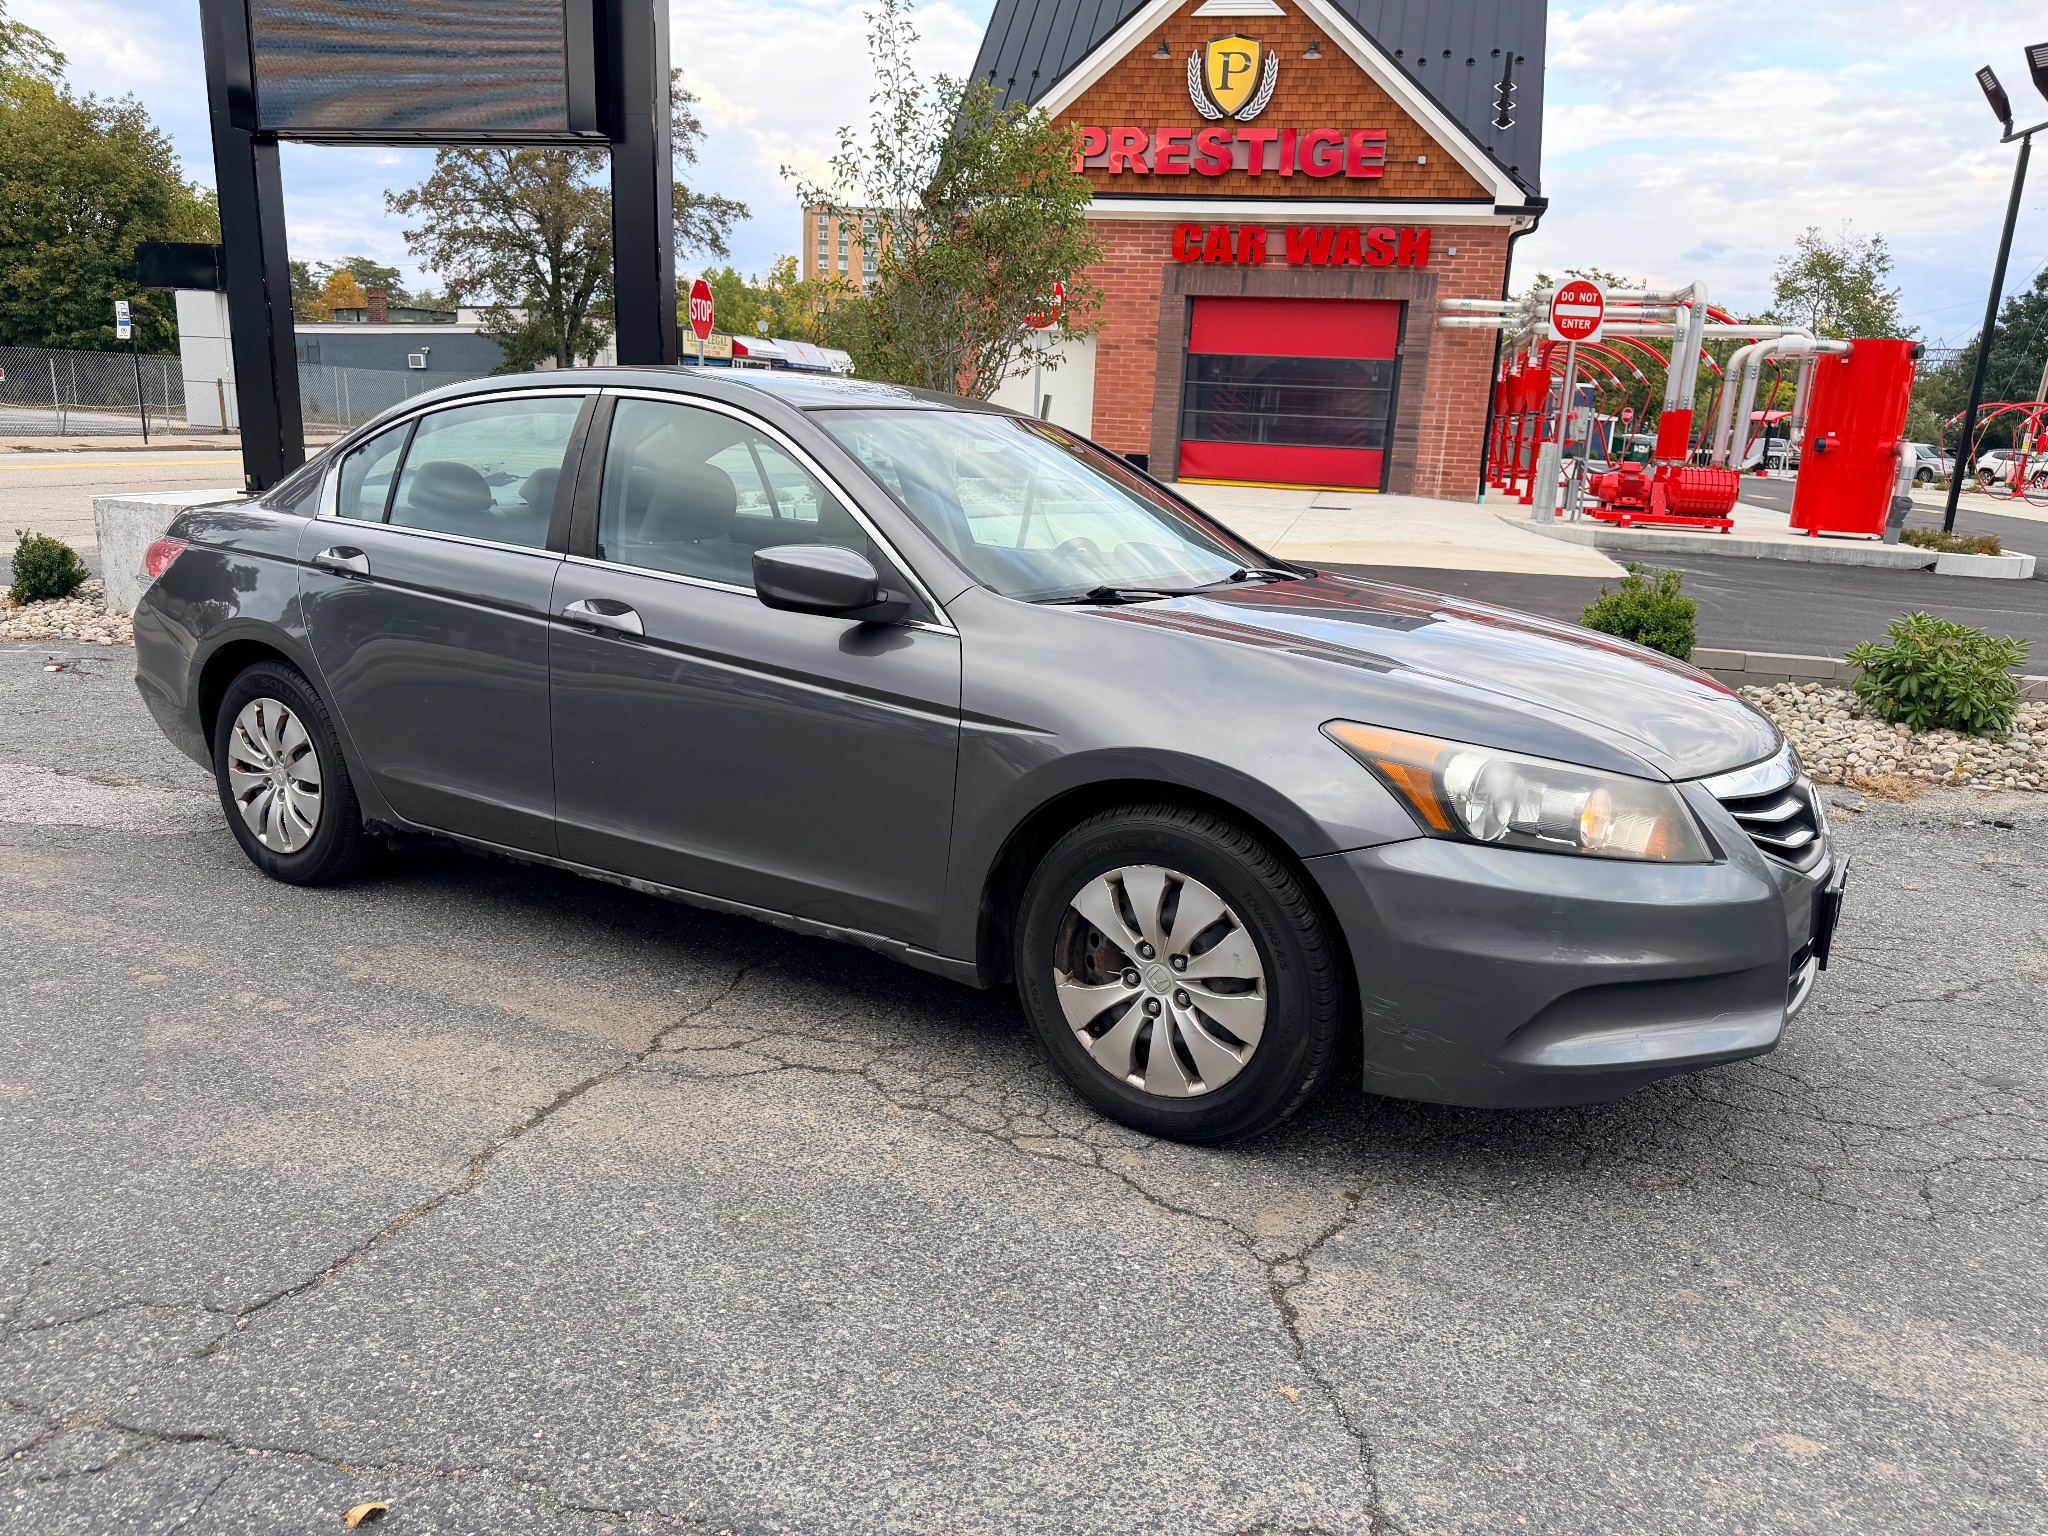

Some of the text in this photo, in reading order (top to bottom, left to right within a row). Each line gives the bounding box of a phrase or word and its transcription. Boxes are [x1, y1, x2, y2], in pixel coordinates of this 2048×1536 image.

[1215, 51, 1251, 91] P
[1070, 126, 1387, 178] PRESTIGE
[1172, 223, 1432, 267] CAR WASH
[691, 297, 712, 322] STOP
[1561, 291, 1598, 303] DO NOT
[1561, 318, 1591, 329] ENTER
[1242, 891, 1281, 946] TOURING
